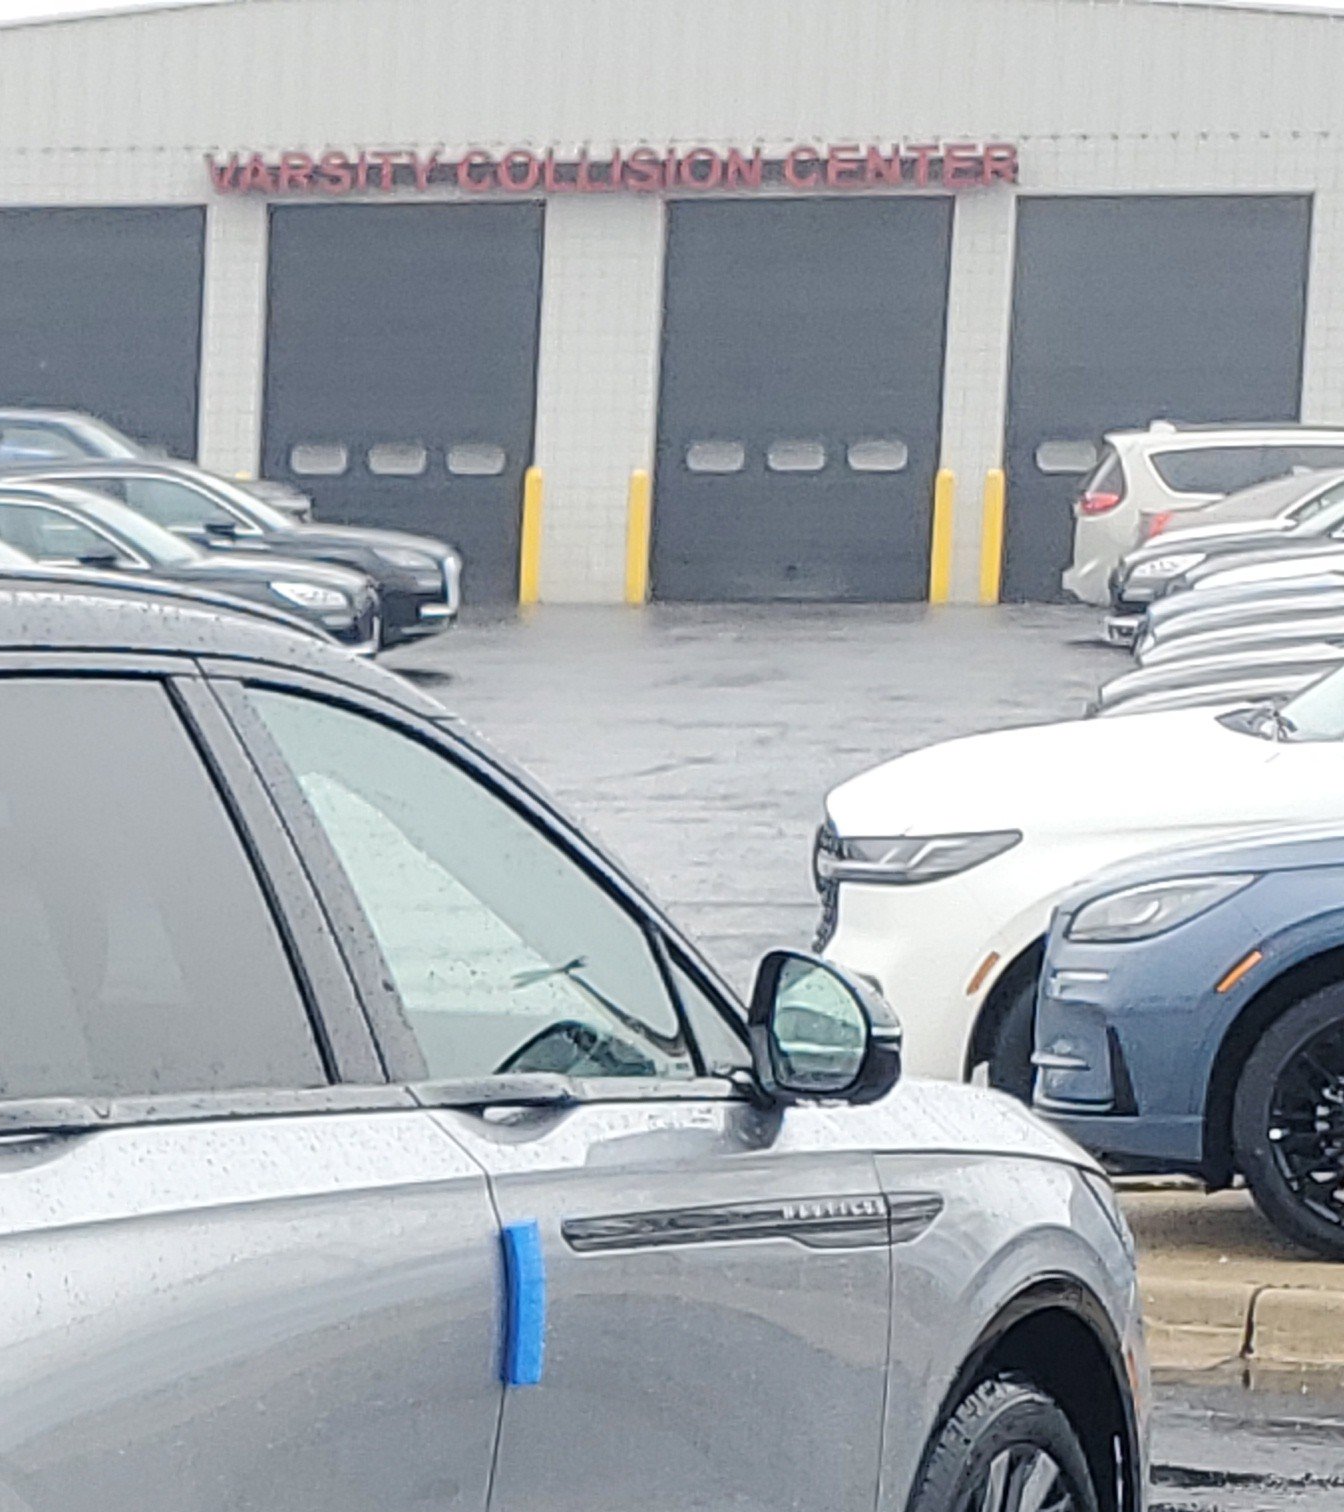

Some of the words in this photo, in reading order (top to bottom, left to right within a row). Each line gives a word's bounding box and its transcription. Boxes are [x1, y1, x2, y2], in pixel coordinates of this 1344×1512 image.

[205, 149, 440, 193] VARSITY
[455, 147, 763, 193] COLLISION
[783, 143, 1019, 189] CENTER
